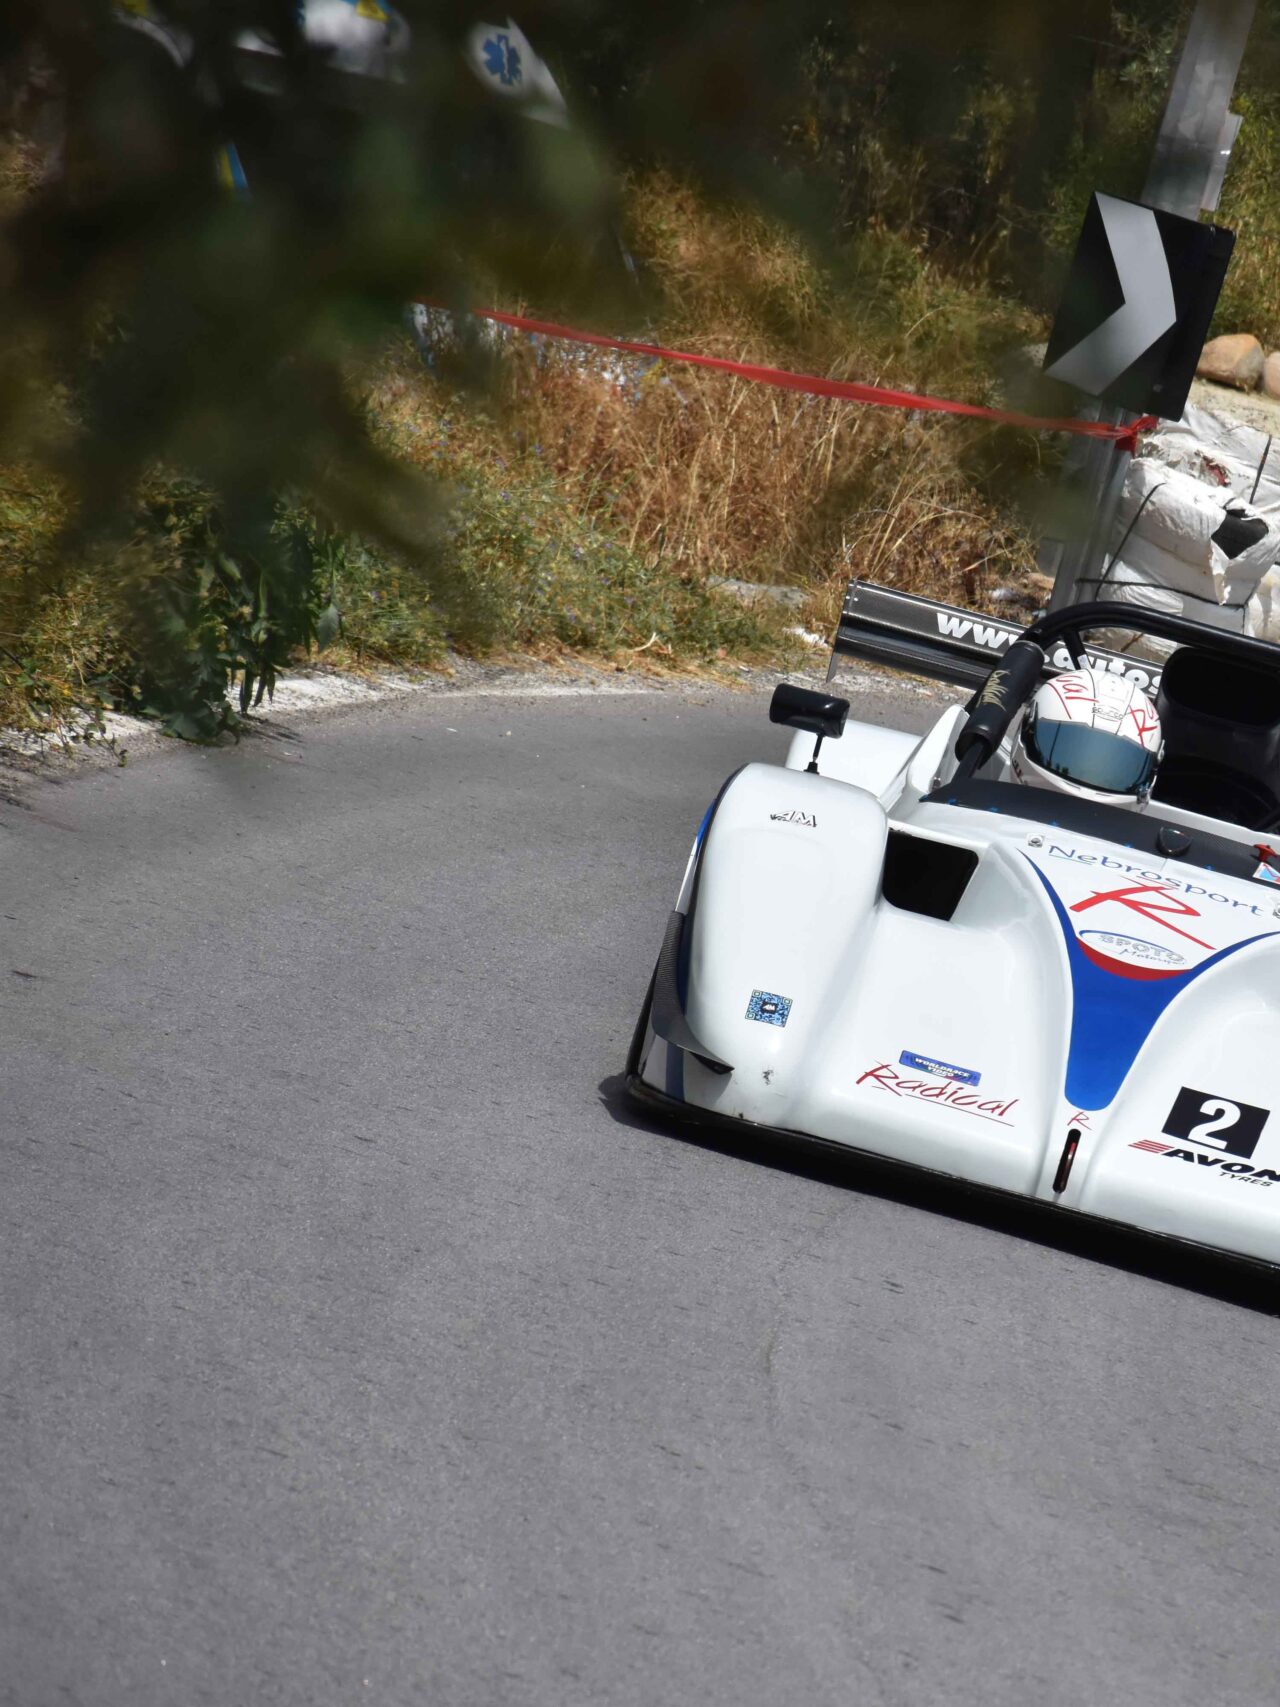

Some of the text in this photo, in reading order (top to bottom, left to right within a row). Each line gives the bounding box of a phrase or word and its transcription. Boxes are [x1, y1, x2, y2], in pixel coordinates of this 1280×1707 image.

[1049, 845, 1264, 917] Nebrosport
[856, 1060, 1019, 1117] Radical
[1187, 1098, 1242, 1150] 2
[1218, 1171, 1273, 1187] TYRES
